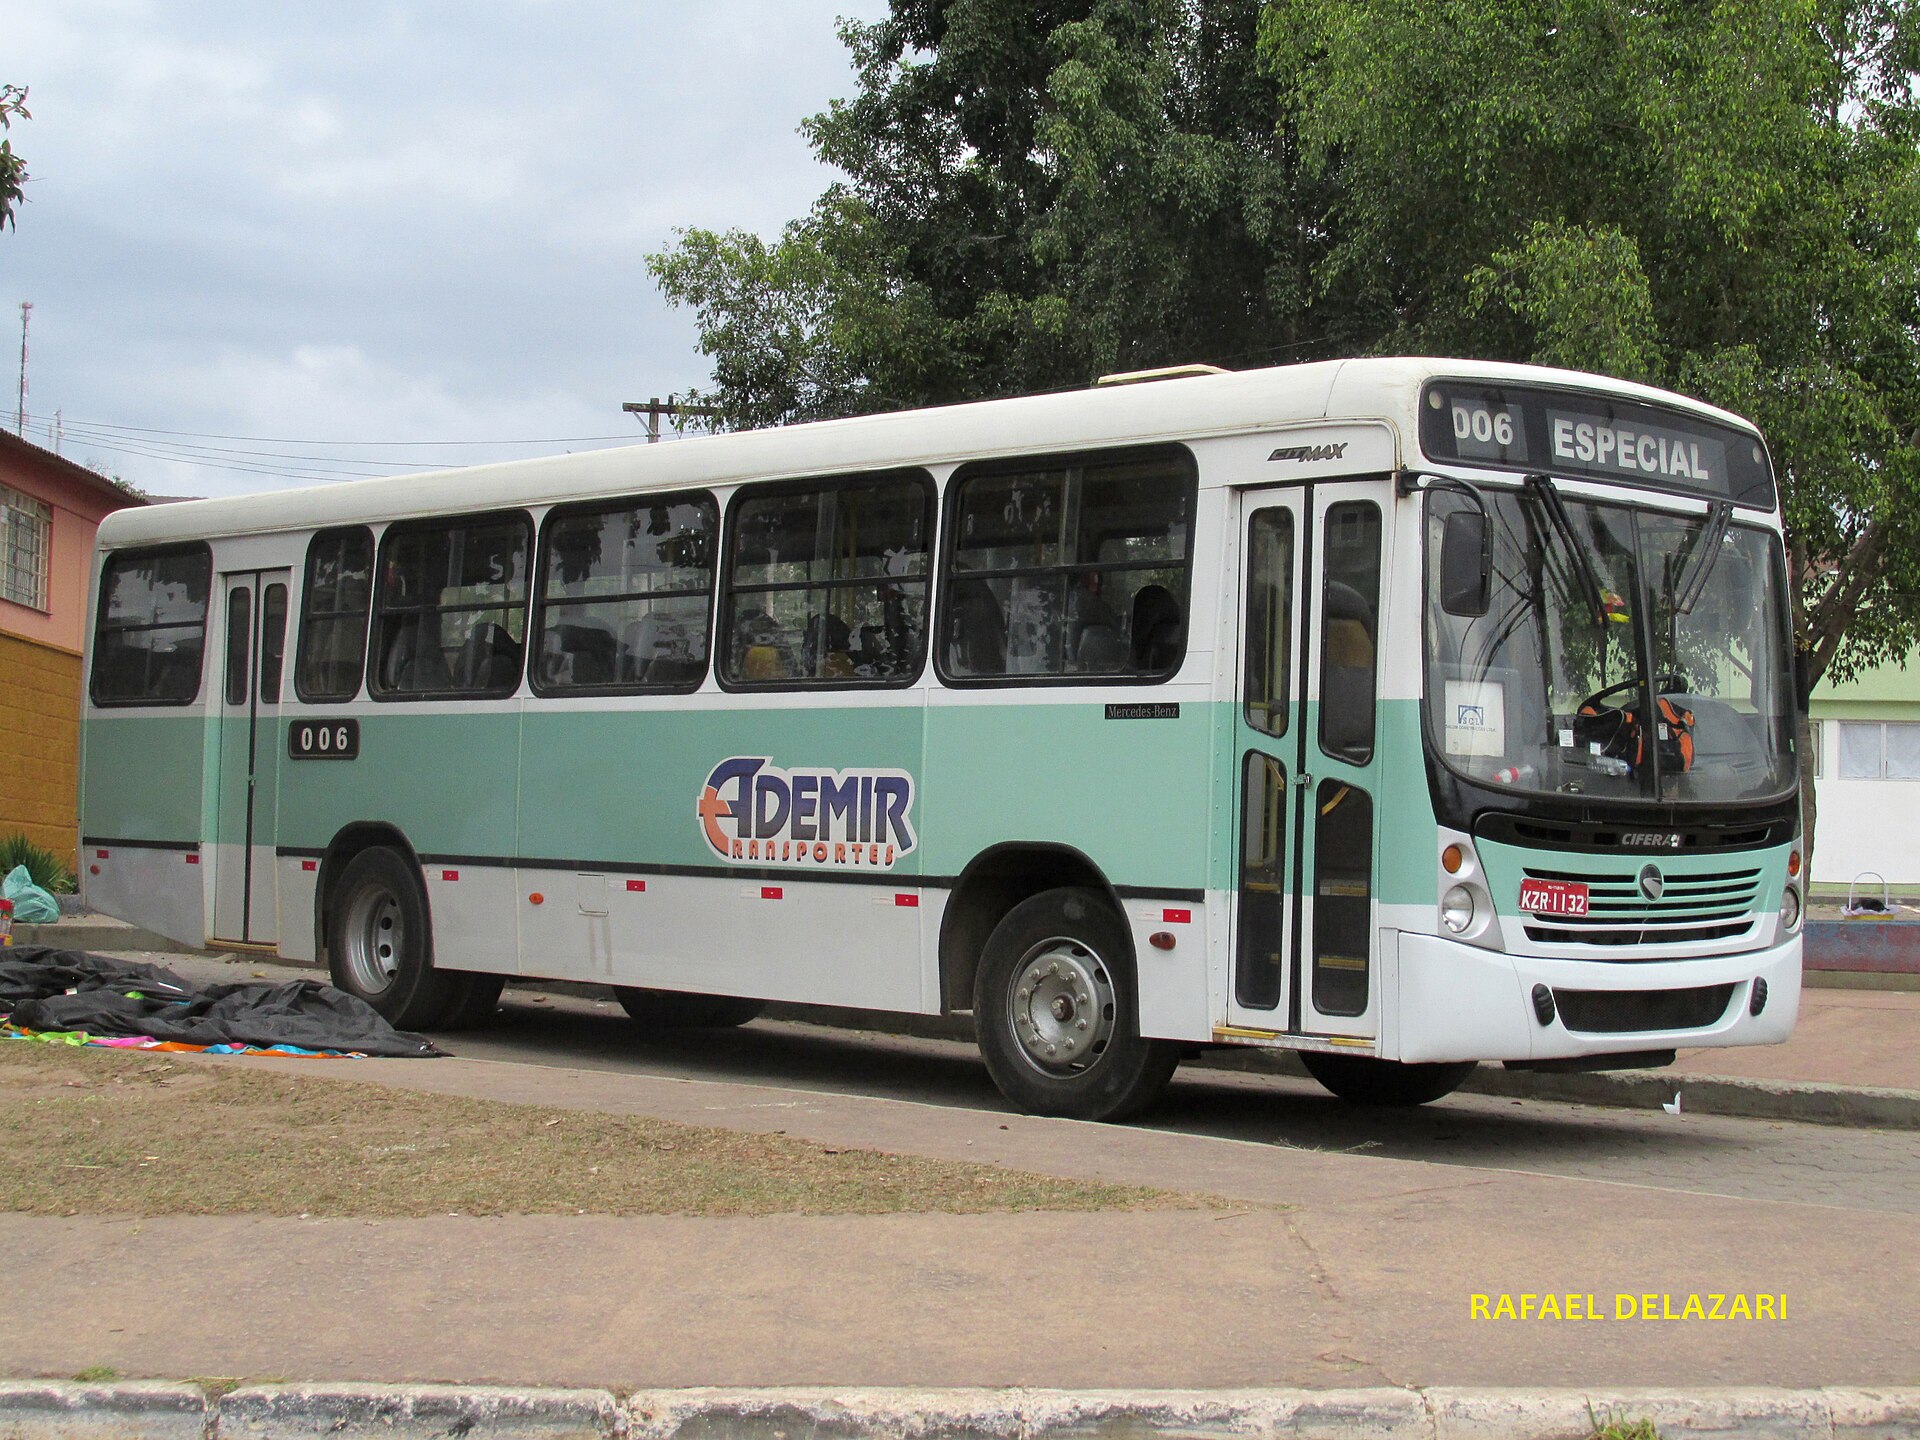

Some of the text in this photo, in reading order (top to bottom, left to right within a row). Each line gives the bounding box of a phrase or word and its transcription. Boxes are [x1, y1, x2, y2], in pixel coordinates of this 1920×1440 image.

[1554, 418, 1709, 480] ESPECIAL
[1108, 704, 1177, 718] Mercedes-Benz
[301, 726, 348, 751] 006
[699, 758, 913, 857] ADEMIR
[1621, 833, 1681, 847] CIFERA
